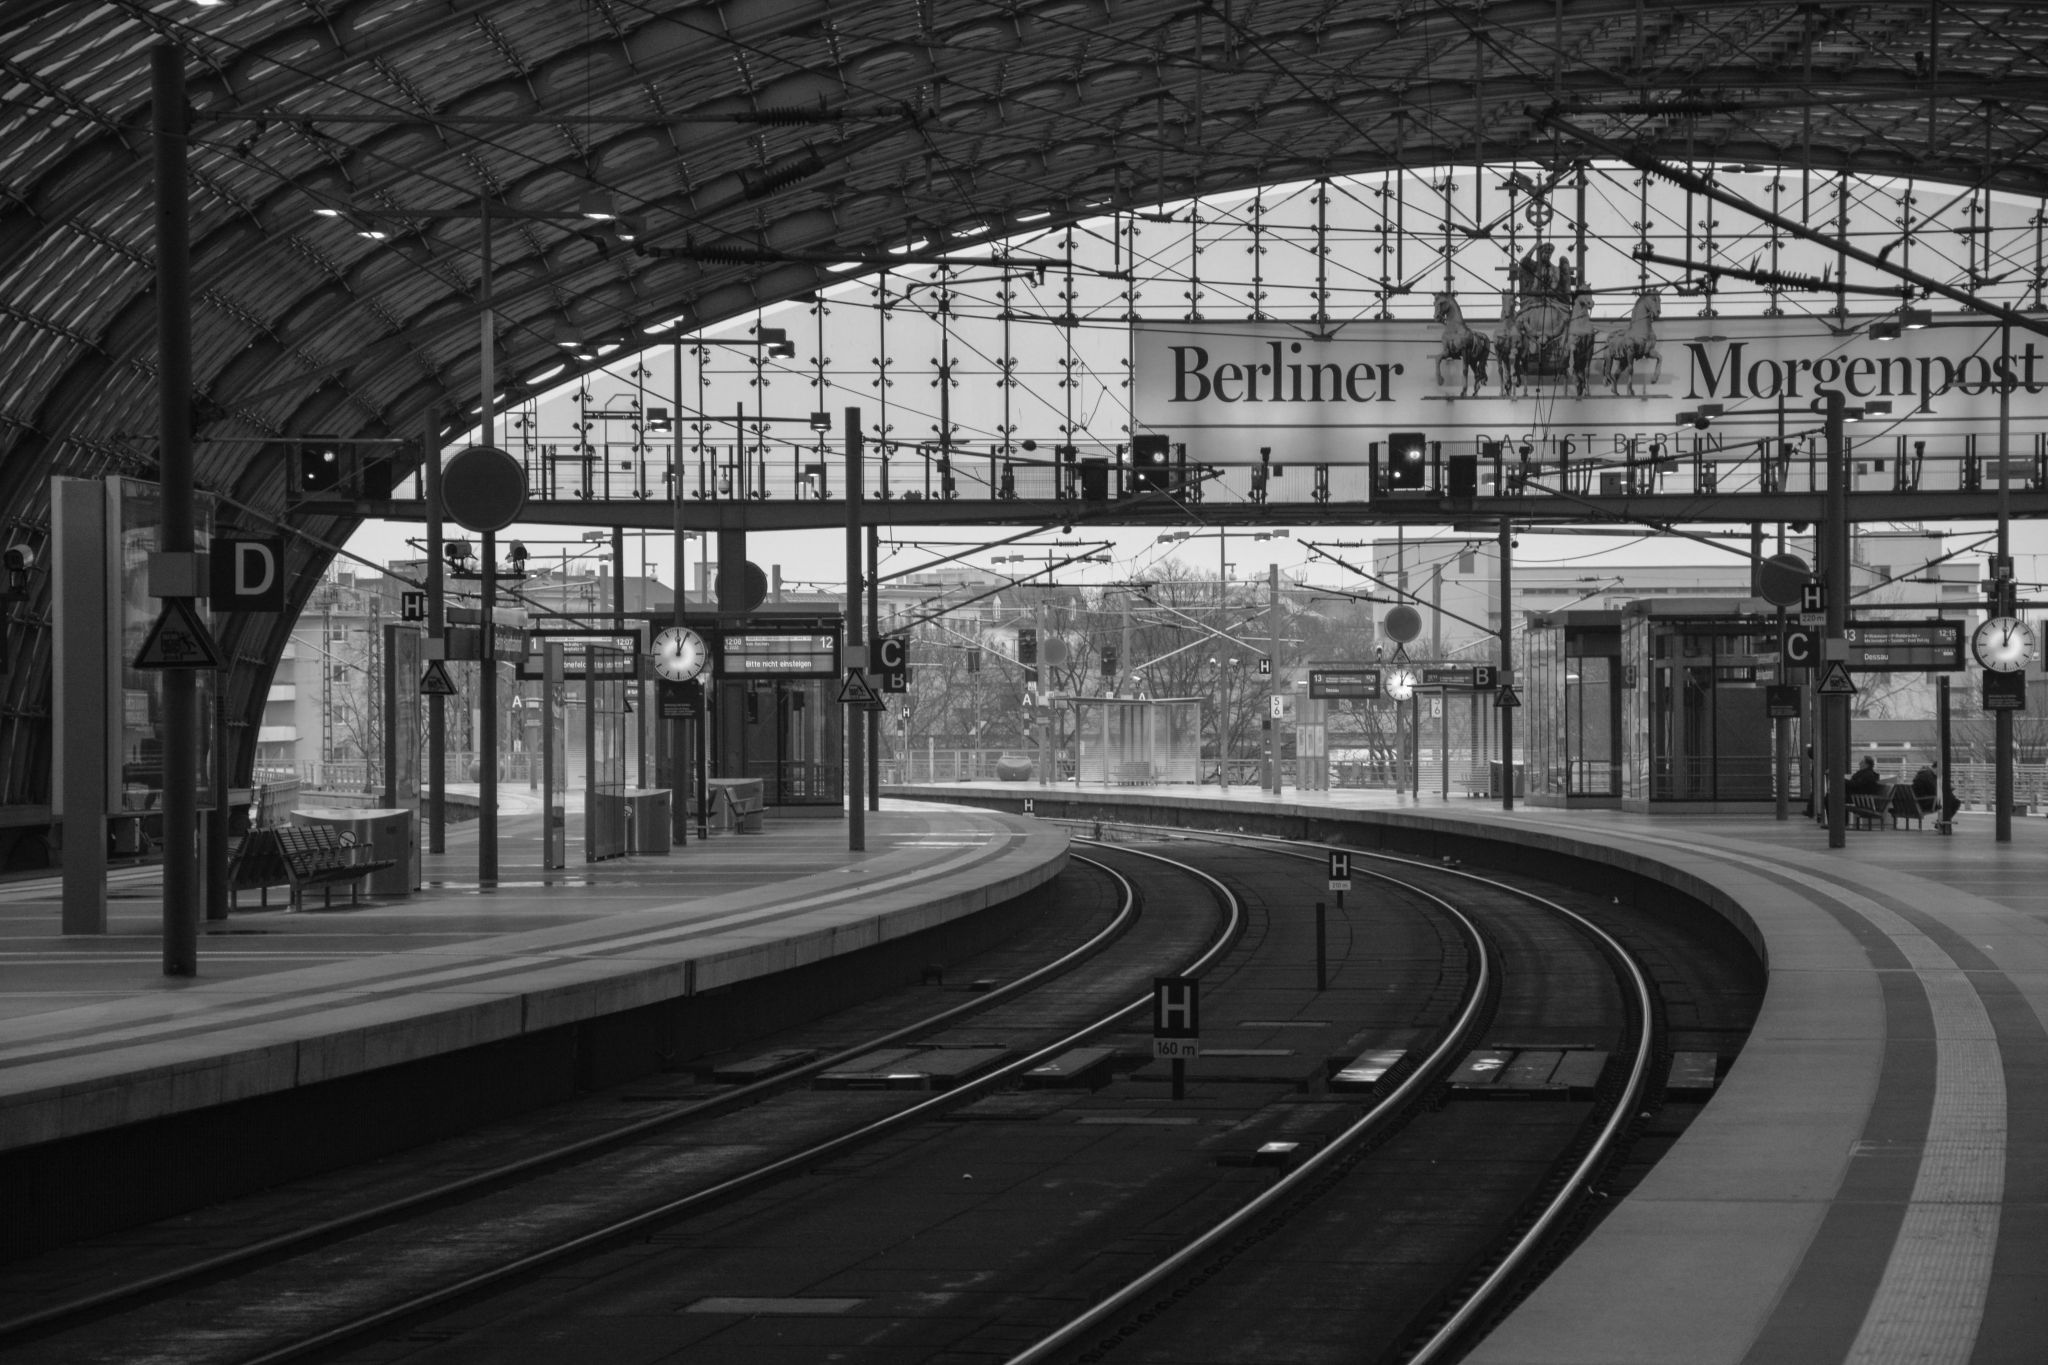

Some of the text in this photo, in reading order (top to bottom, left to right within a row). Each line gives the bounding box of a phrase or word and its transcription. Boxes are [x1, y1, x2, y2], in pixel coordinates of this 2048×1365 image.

[1168, 341, 2046, 415] Berliner Morgenpost
[1476, 432, 1723, 455] DAS IST BERLIN
[234, 542, 275, 596] D
[1804, 586, 1821, 609] H
[404, 595, 420, 617] H
[1843, 628, 1857, 642] 13
[819, 636, 834, 649] 12
[1787, 632, 1809, 661] C
[880, 640, 902, 667] C
[1864, 653, 1889, 661] Dessau
[745, 660, 812, 669] Bitte nicht einsteigen
[1260, 660, 1270, 673] H
[1476, 668, 1489, 685] B
[512, 695, 523, 708] A
[1022, 693, 1032, 706] A
[1273, 696, 1280, 706] 5
[903, 708, 910, 717] H
[1273, 706, 1280, 716] 6
[1024, 799, 1033, 811] H
[1332, 855, 1348, 876] H
[1161, 985, 1191, 1029] H
[1157, 1042, 1196, 1056] 160 m
